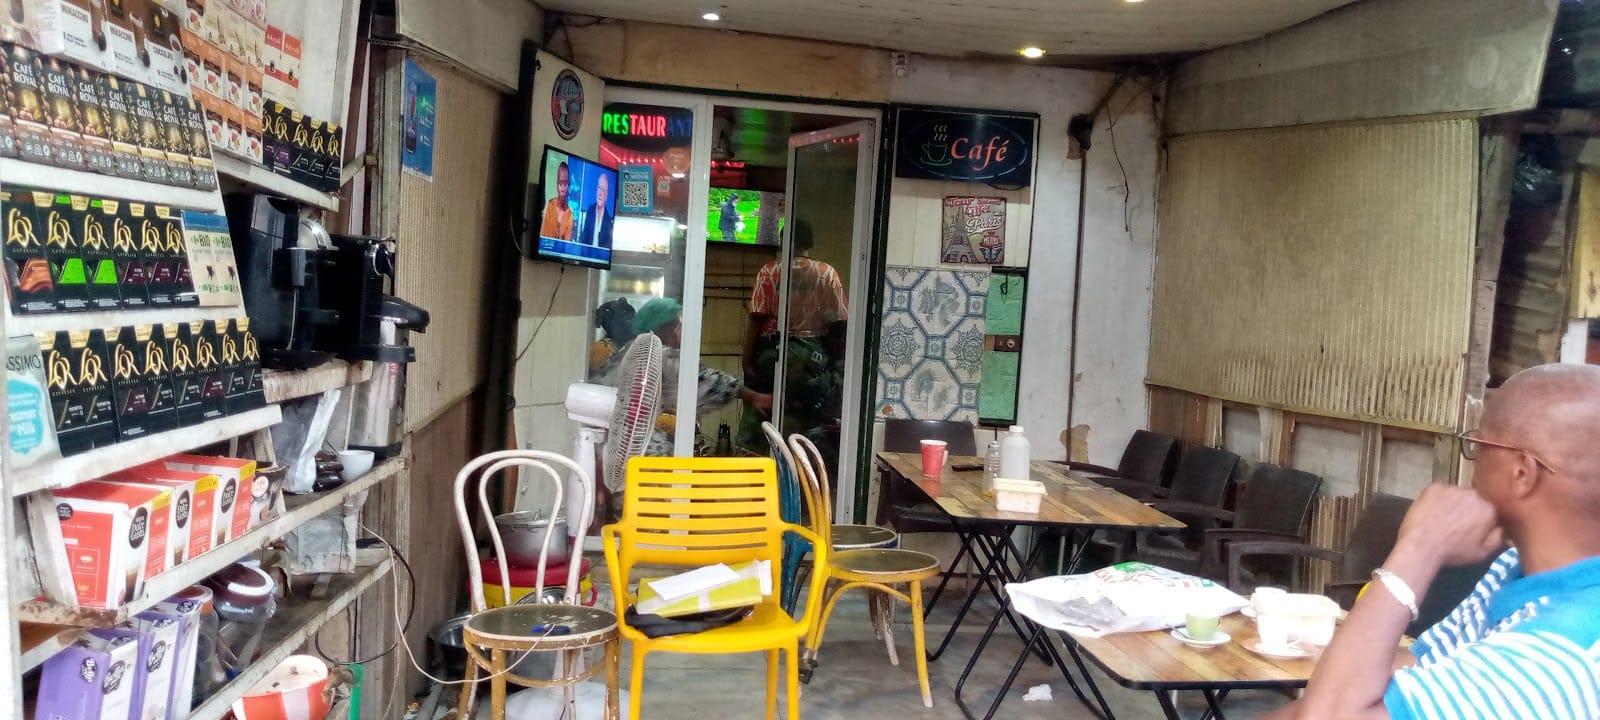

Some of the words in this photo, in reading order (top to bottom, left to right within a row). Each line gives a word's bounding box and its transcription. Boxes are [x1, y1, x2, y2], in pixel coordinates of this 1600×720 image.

[14, 62, 34, 77] CAFÉ
[13, 72, 38, 88] ROYAL
[48, 73, 66, 87] CAFÉ
[48, 83, 71, 97] ROYAL
[79, 82, 95, 96] CAFÉ
[79, 91, 100, 106] ROYAL
[951, 136, 1010, 171] Café
[966, 216, 1001, 233] Paris
[6, 354, 42, 371] SSIMO
